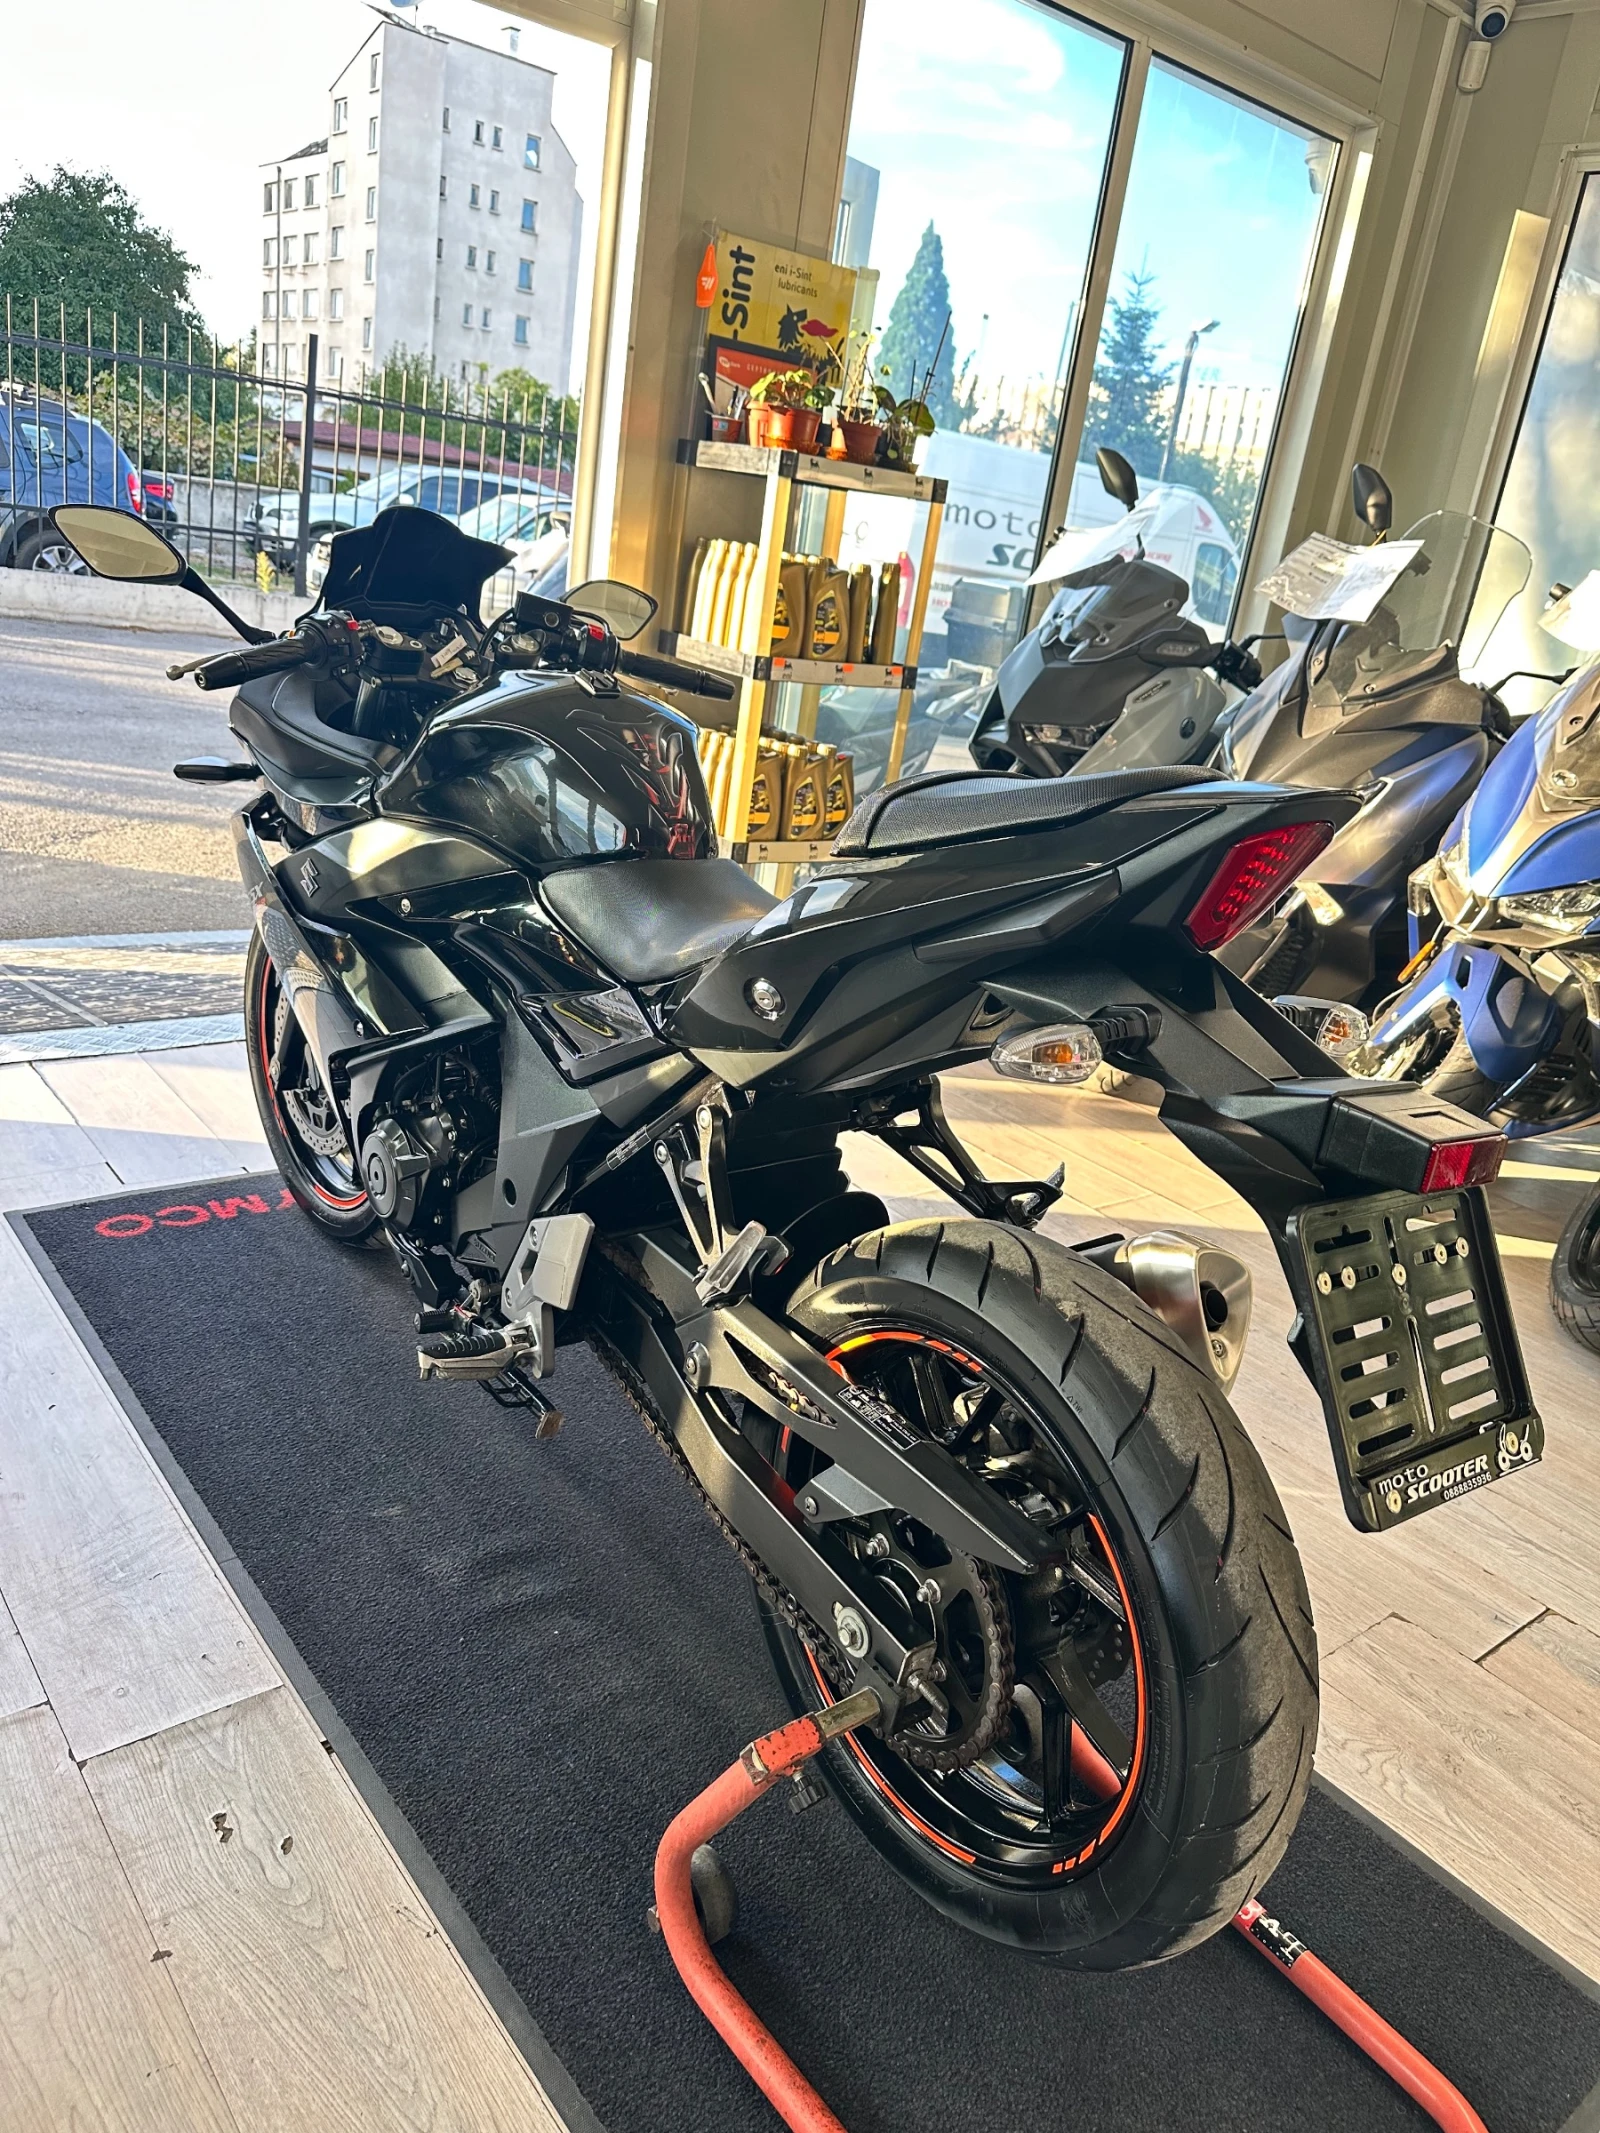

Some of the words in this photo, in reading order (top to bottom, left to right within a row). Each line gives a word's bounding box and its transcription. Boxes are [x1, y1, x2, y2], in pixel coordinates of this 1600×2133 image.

[774, 263, 788, 274] eni
[789, 267, 812, 282] i-Sint
[777, 277, 818, 298] lubricants
[721, 245, 756, 341] -Sint
[1377, 1464, 1429, 1495] moto
[1407, 1454, 1489, 1504] SCOOTER
[1443, 1471, 1492, 1501] 0888835936
